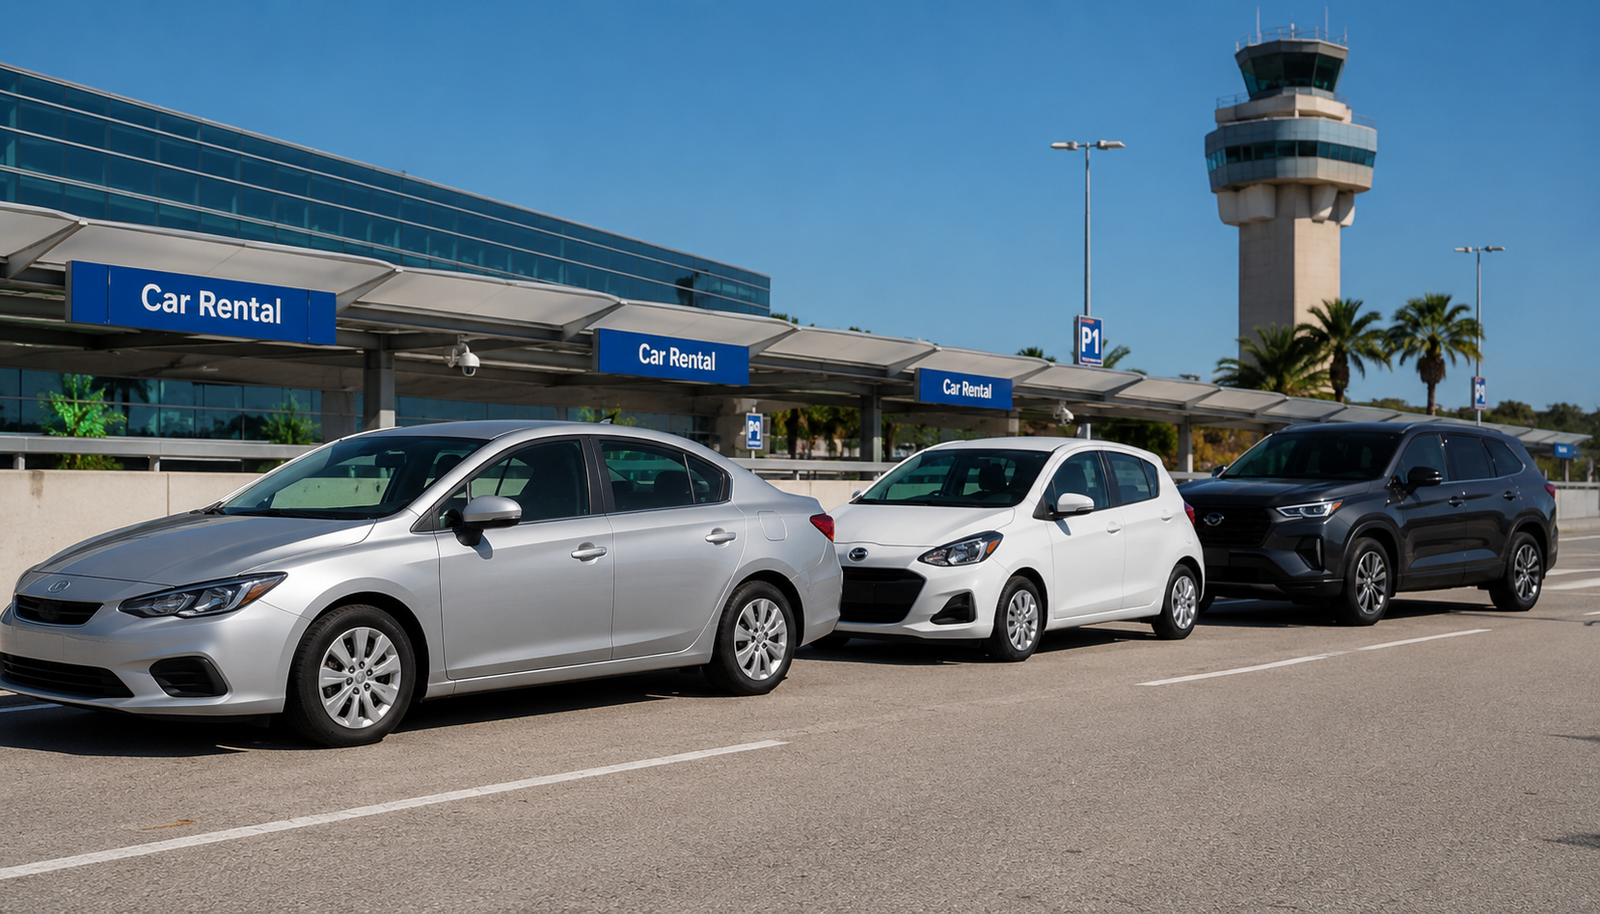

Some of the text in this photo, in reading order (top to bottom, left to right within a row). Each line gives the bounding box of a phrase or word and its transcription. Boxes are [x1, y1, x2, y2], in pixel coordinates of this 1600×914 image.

[141, 283, 281, 324] Car Rental
[1081, 326, 1099, 354] P1
[638, 342, 716, 371] Car Rental
[942, 378, 992, 399] Car Rental
